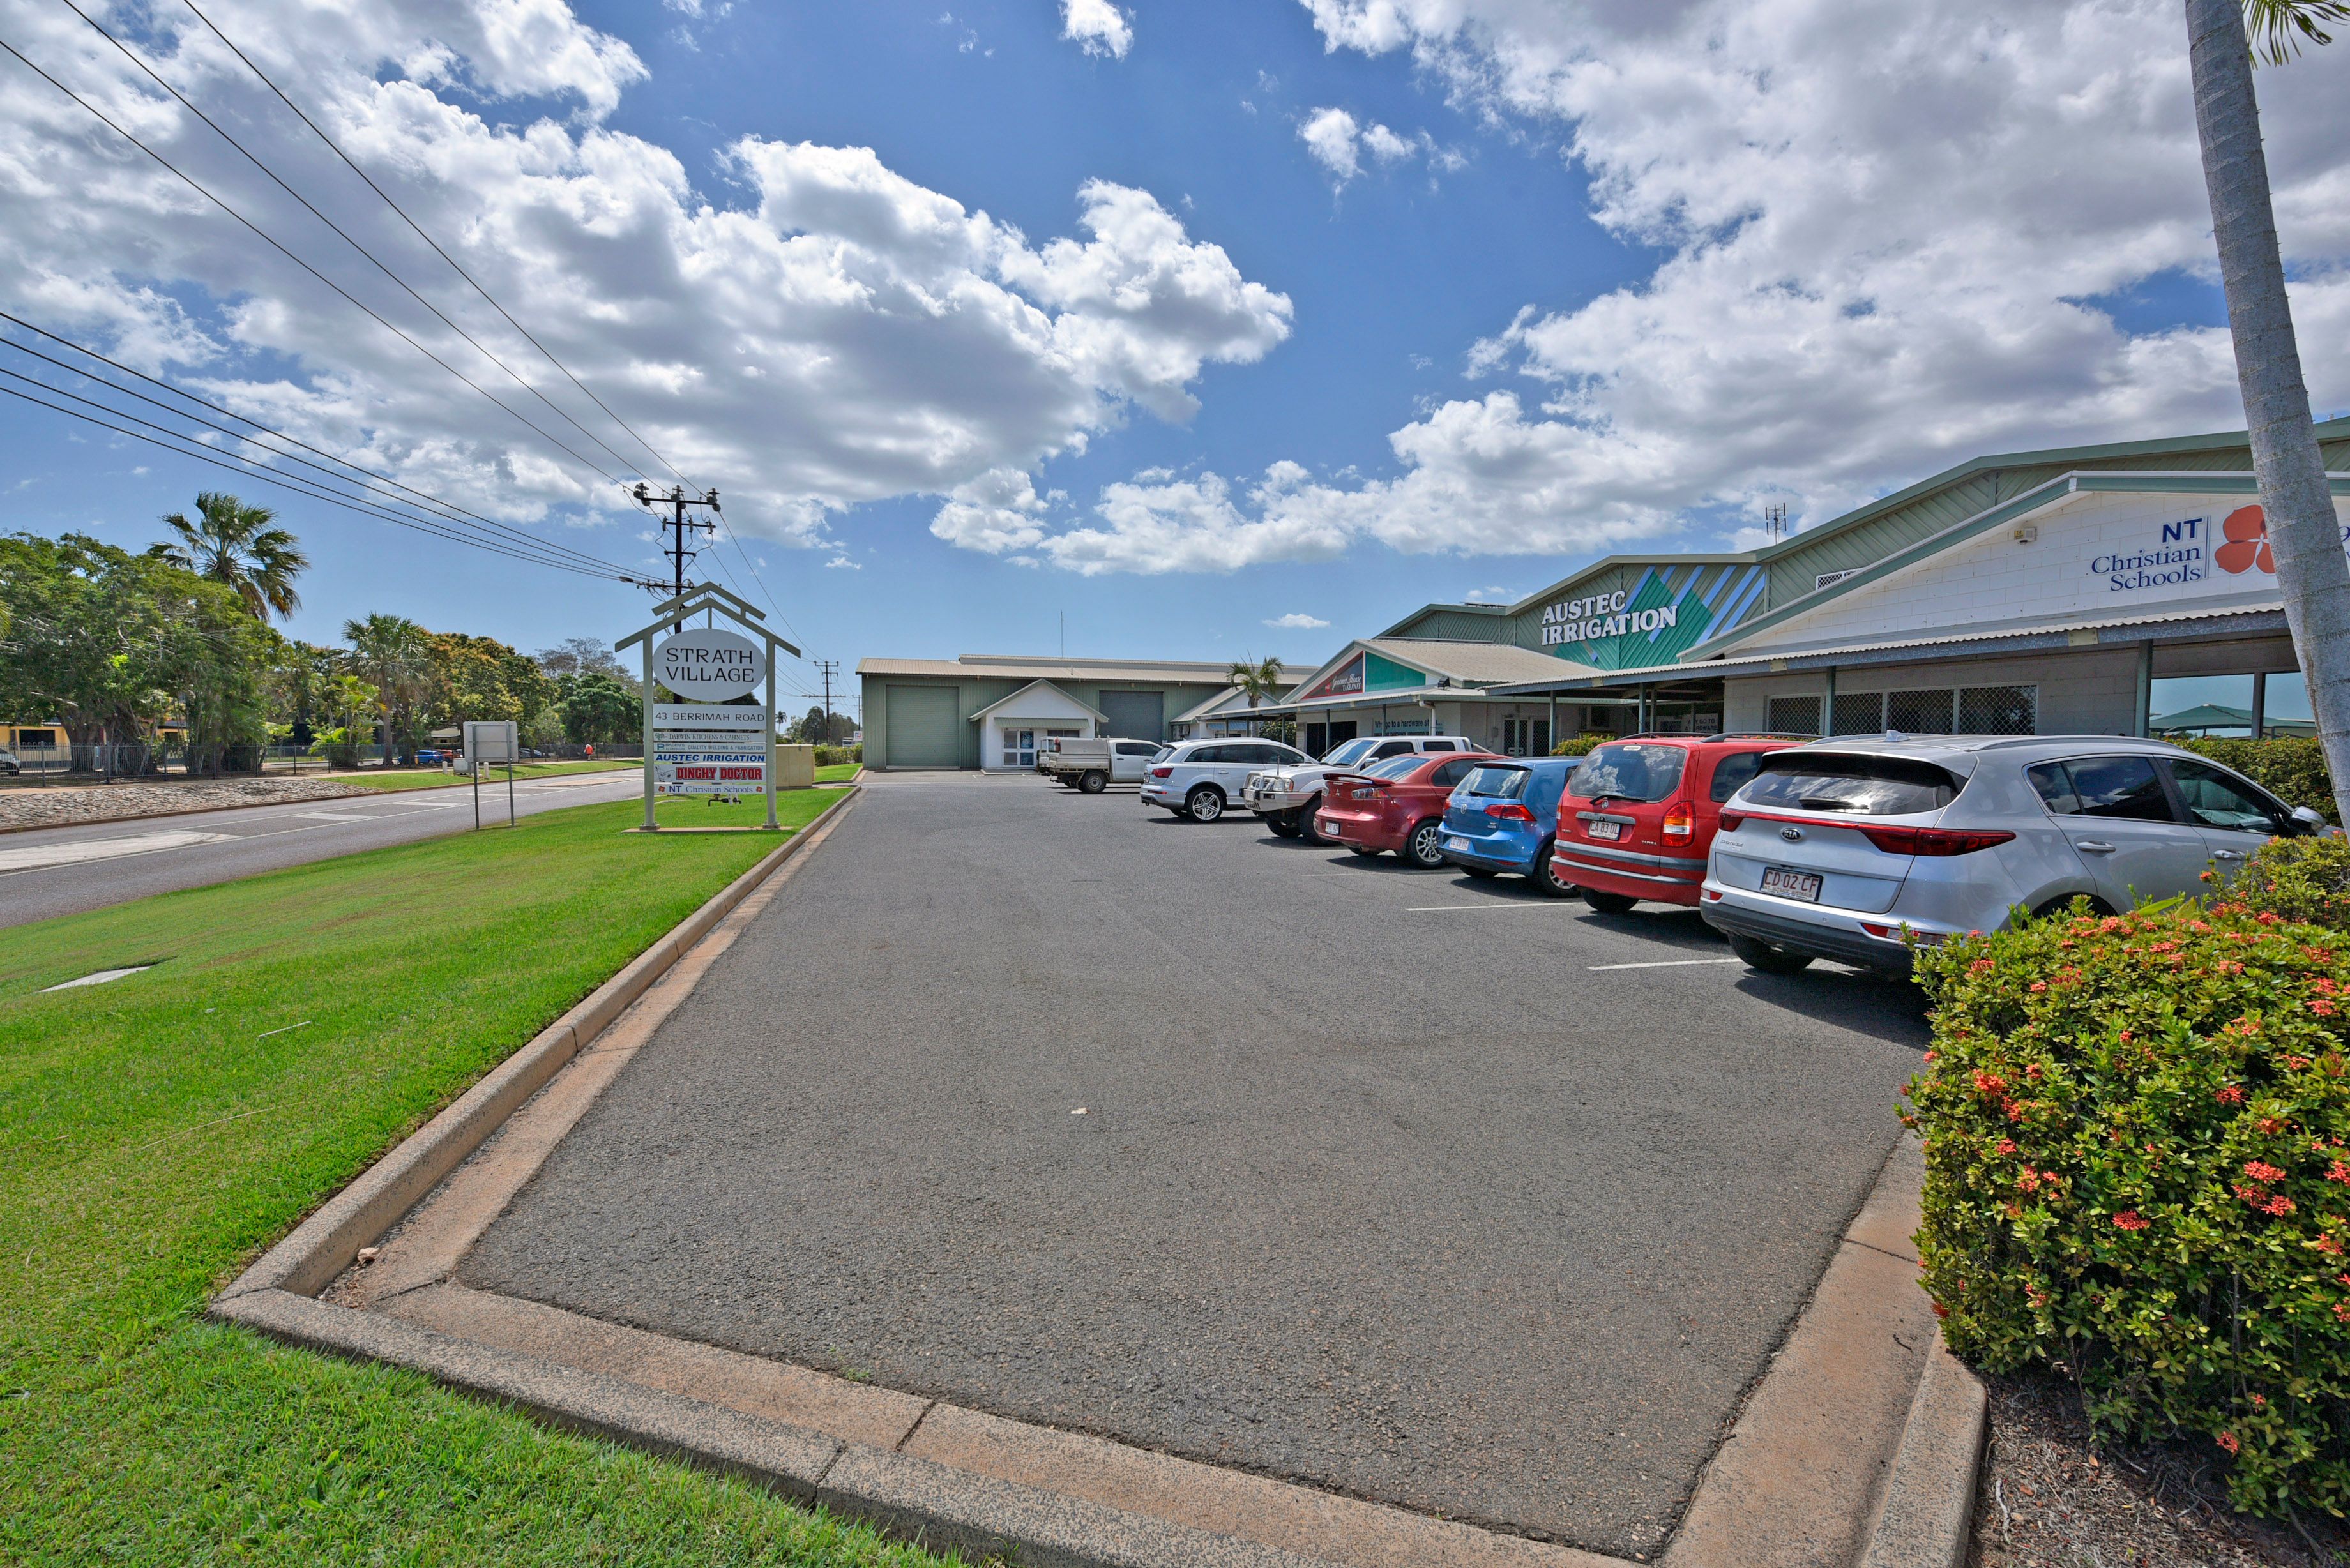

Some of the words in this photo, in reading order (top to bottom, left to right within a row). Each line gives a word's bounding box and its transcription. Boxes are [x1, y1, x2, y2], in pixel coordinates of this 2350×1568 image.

[2162, 518, 2202, 543] NT
[2091, 547, 2201, 575] Christian
[2110, 566, 2201, 591] Schools
[1541, 590, 1626, 625] AUSTEC
[1540, 605, 1678, 646] IRRIGATION
[667, 647, 753, 664] STRATH
[665, 666, 754, 682] VILLAGE
[1342, 683, 1361, 691] TAKEAWAY
[655, 712, 667, 720] 43
[673, 712, 730, 721] BERRIMAH
[1401, 719, 1423, 727] hardware
[702, 754, 765, 762] IRRIGATION
[676, 766, 717, 780] DINGHY
[719, 767, 762, 780] DOCTOR
[1784, 830, 1798, 838] KIA
